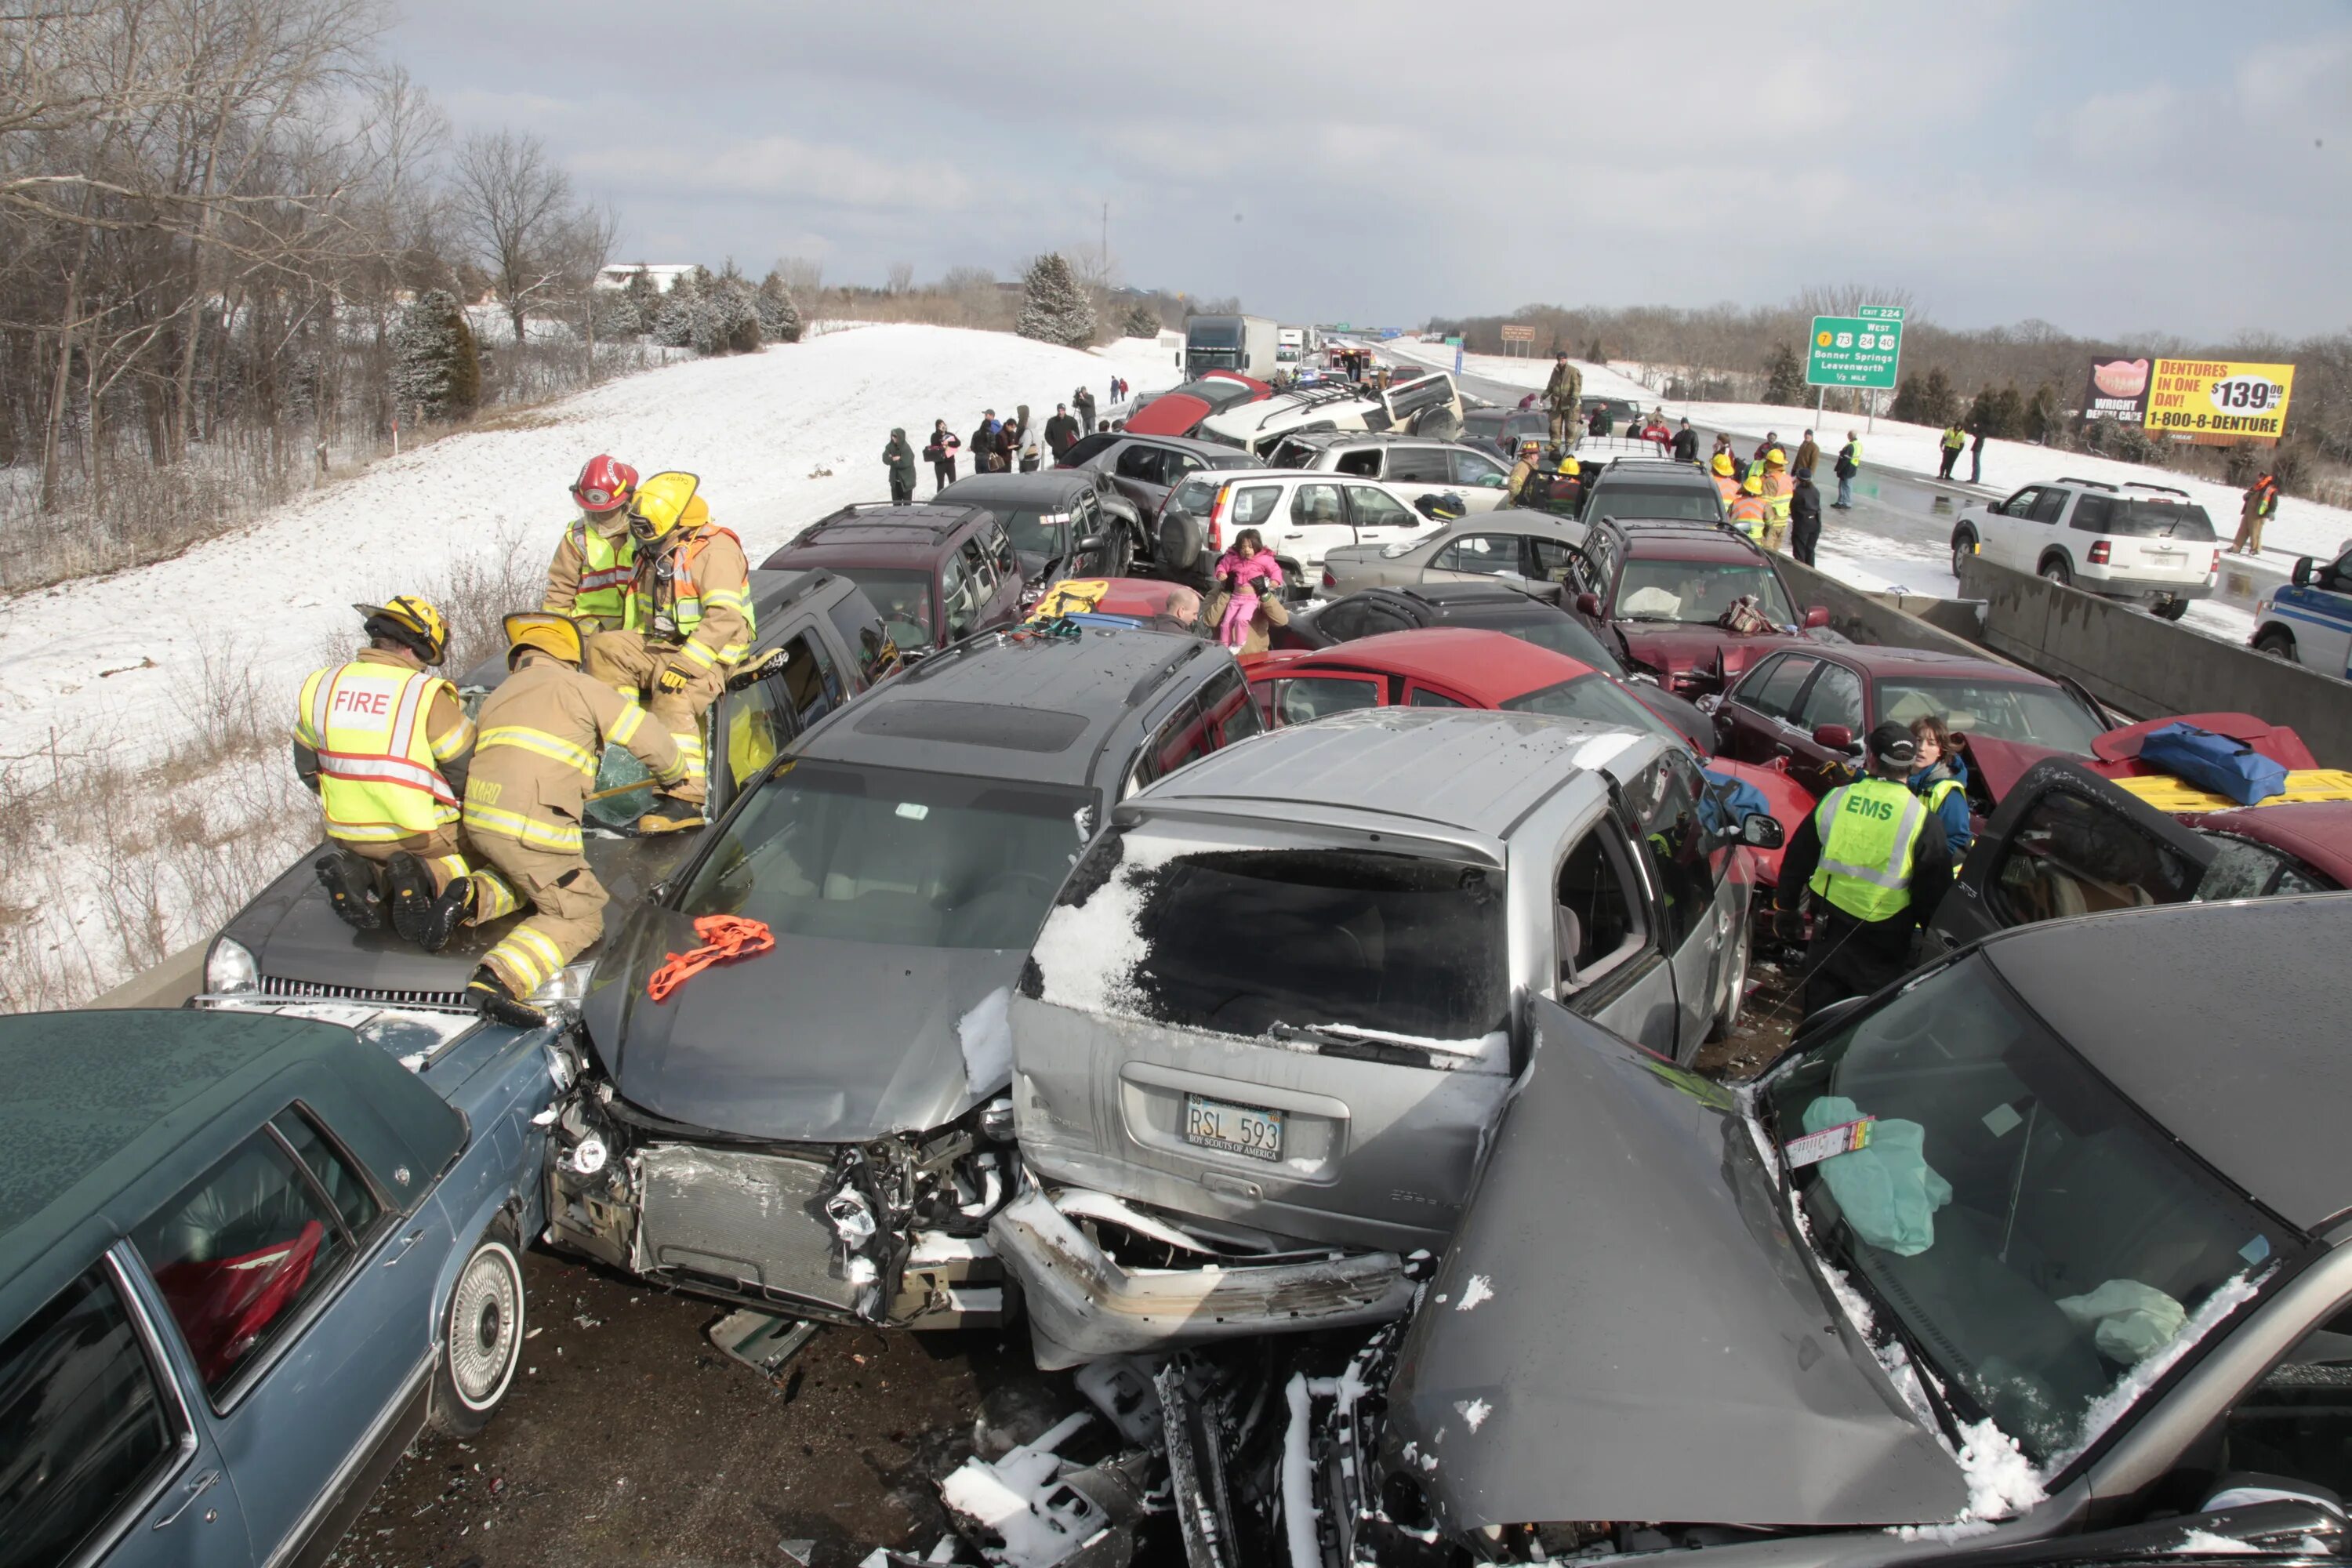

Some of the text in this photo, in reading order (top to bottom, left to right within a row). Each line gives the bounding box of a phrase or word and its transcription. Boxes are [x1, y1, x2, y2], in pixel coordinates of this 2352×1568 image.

[1881, 309, 1900, 318] 224
[1867, 323, 1890, 332] WEST
[1838, 336, 1849, 345] 73
[1860, 336, 1873, 346] 24
[1881, 339, 1893, 347] 40
[1814, 350, 1893, 364] Bonner Springs
[1821, 361, 1884, 372] Leavenworth
[2160, 361, 2228, 378] DENTURES
[2157, 377, 2201, 392] IN ONE
[2094, 398, 2138, 411] WRIGHT
[2154, 393, 2184, 408] DAY!
[2150, 411, 2278, 433] 1-800-8-DENTURE
[334, 691, 390, 715] FIRE
[1846, 795, 1893, 821] EMS
[1191, 1094, 1201, 1105] SG
[1189, 1109, 1278, 1149] RSL 593
[1189, 1134, 1276, 1160] BOY SCOUTS OF AMERICA
